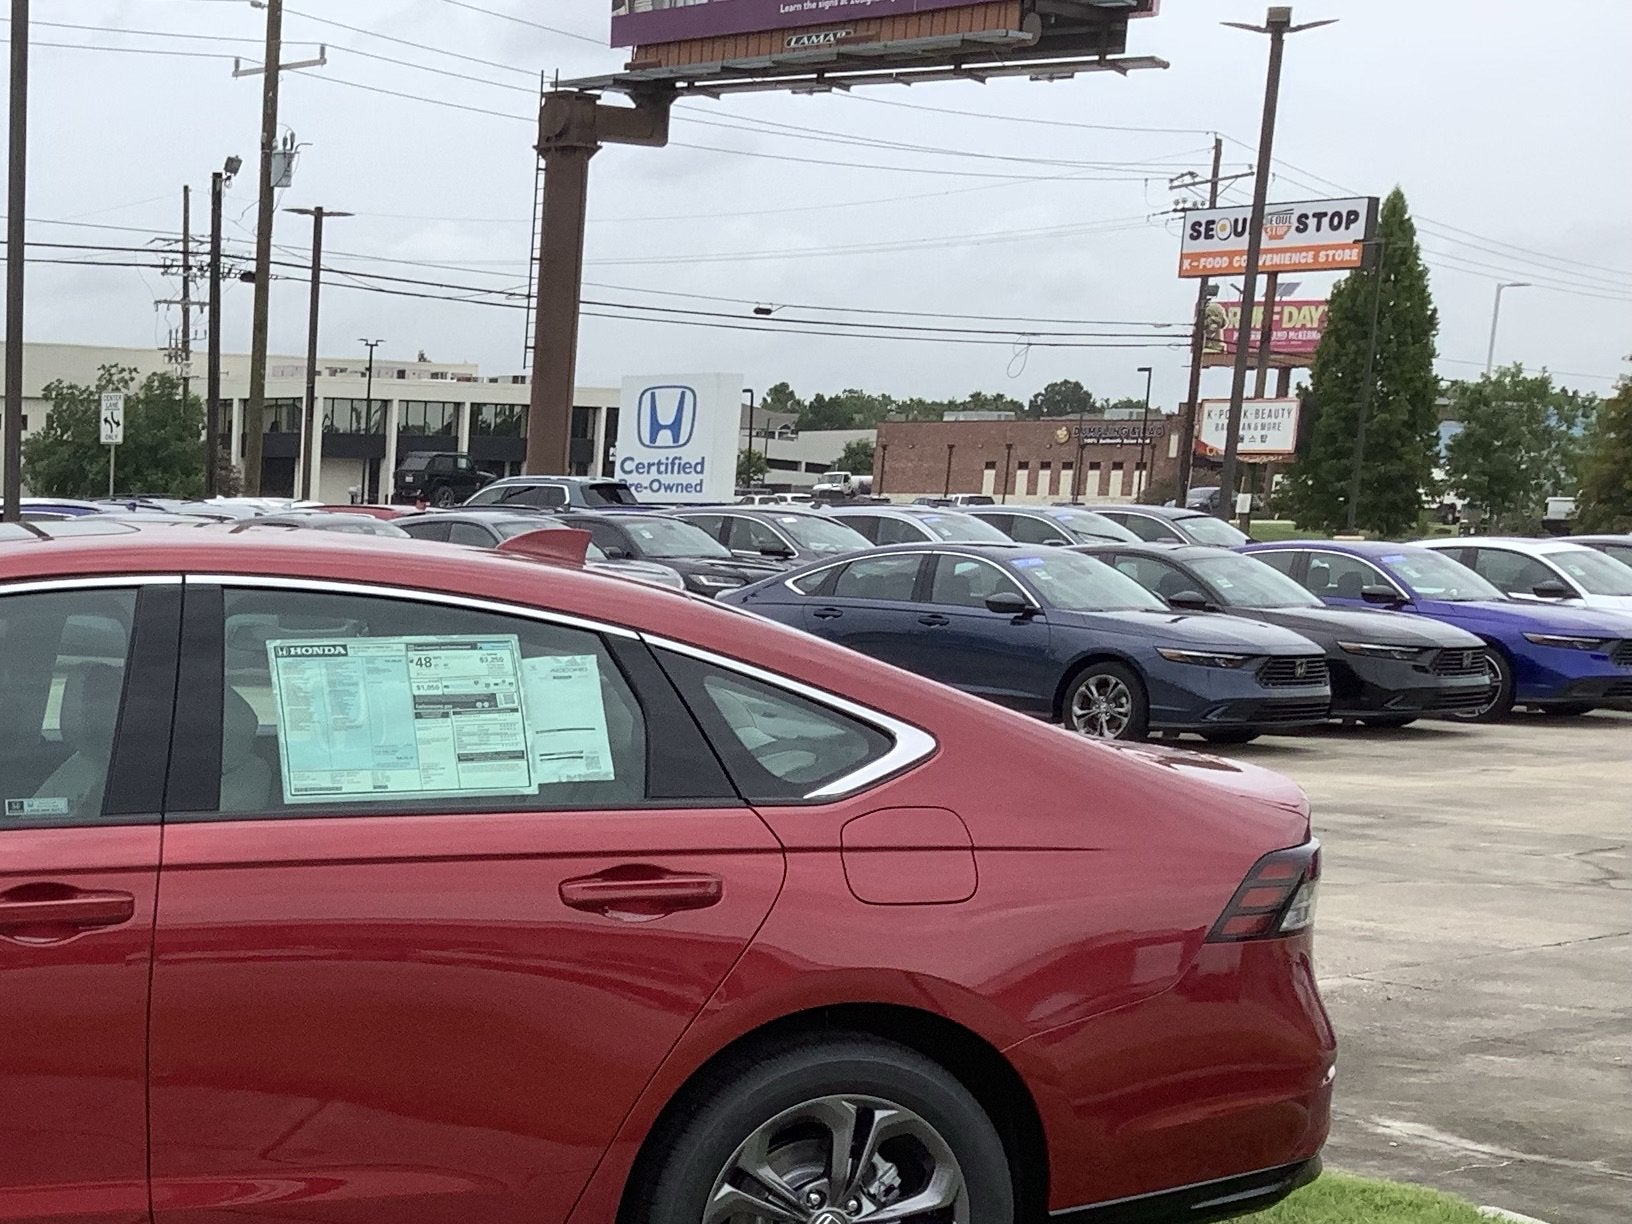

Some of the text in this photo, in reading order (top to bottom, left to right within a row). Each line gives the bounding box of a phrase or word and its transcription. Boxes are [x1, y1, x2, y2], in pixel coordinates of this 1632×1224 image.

[779, 3, 802, 13] Learn
[803, 1, 817, 10] the
[1189, 217, 1250, 241] SEOU
[1295, 209, 1360, 234] STOP
[1183, 248, 1359, 271] K-FOOD COVENIENCE STORE
[1208, 408, 1293, 420] K-PO K-BEAUTY
[620, 456, 705, 475] Certified
[289, 646, 347, 656] HONDA
[415, 656, 432, 668] 48
